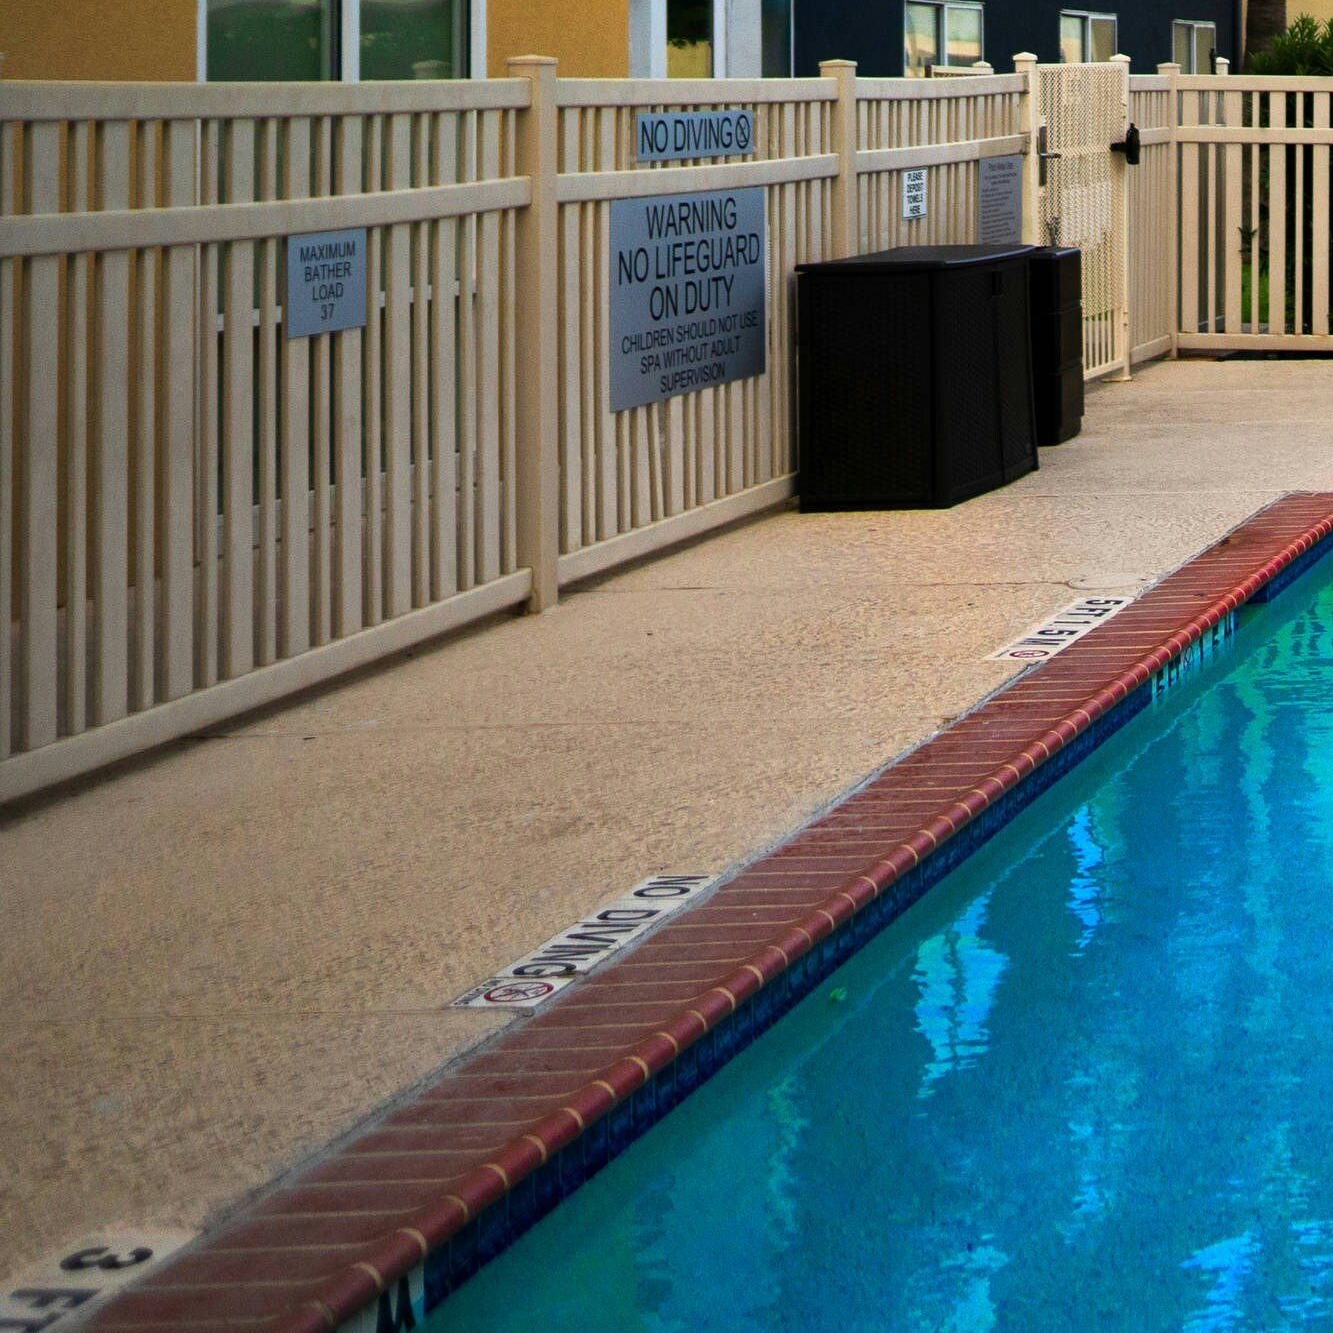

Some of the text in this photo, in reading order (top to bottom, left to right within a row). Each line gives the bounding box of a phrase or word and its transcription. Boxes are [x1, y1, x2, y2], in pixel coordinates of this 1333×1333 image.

[641, 116, 733, 154] NO DIVING
[646, 197, 737, 240] WARNING
[300, 241, 356, 263] MAXIMUM
[618, 233, 760, 286] NO LIFEGUARD
[304, 262, 351, 282] BATHER
[312, 282, 344, 301] LOAD
[650, 274, 735, 321] ON DUTY
[320, 303, 335, 321] 37
[621, 310, 758, 354] CHILDREN SHOULD NOT USE
[640, 336, 741, 374] SPA WITHOUT ADULT
[661, 362, 725, 394] SUPERVISION
[511, 874, 710, 978] NO DIVING
